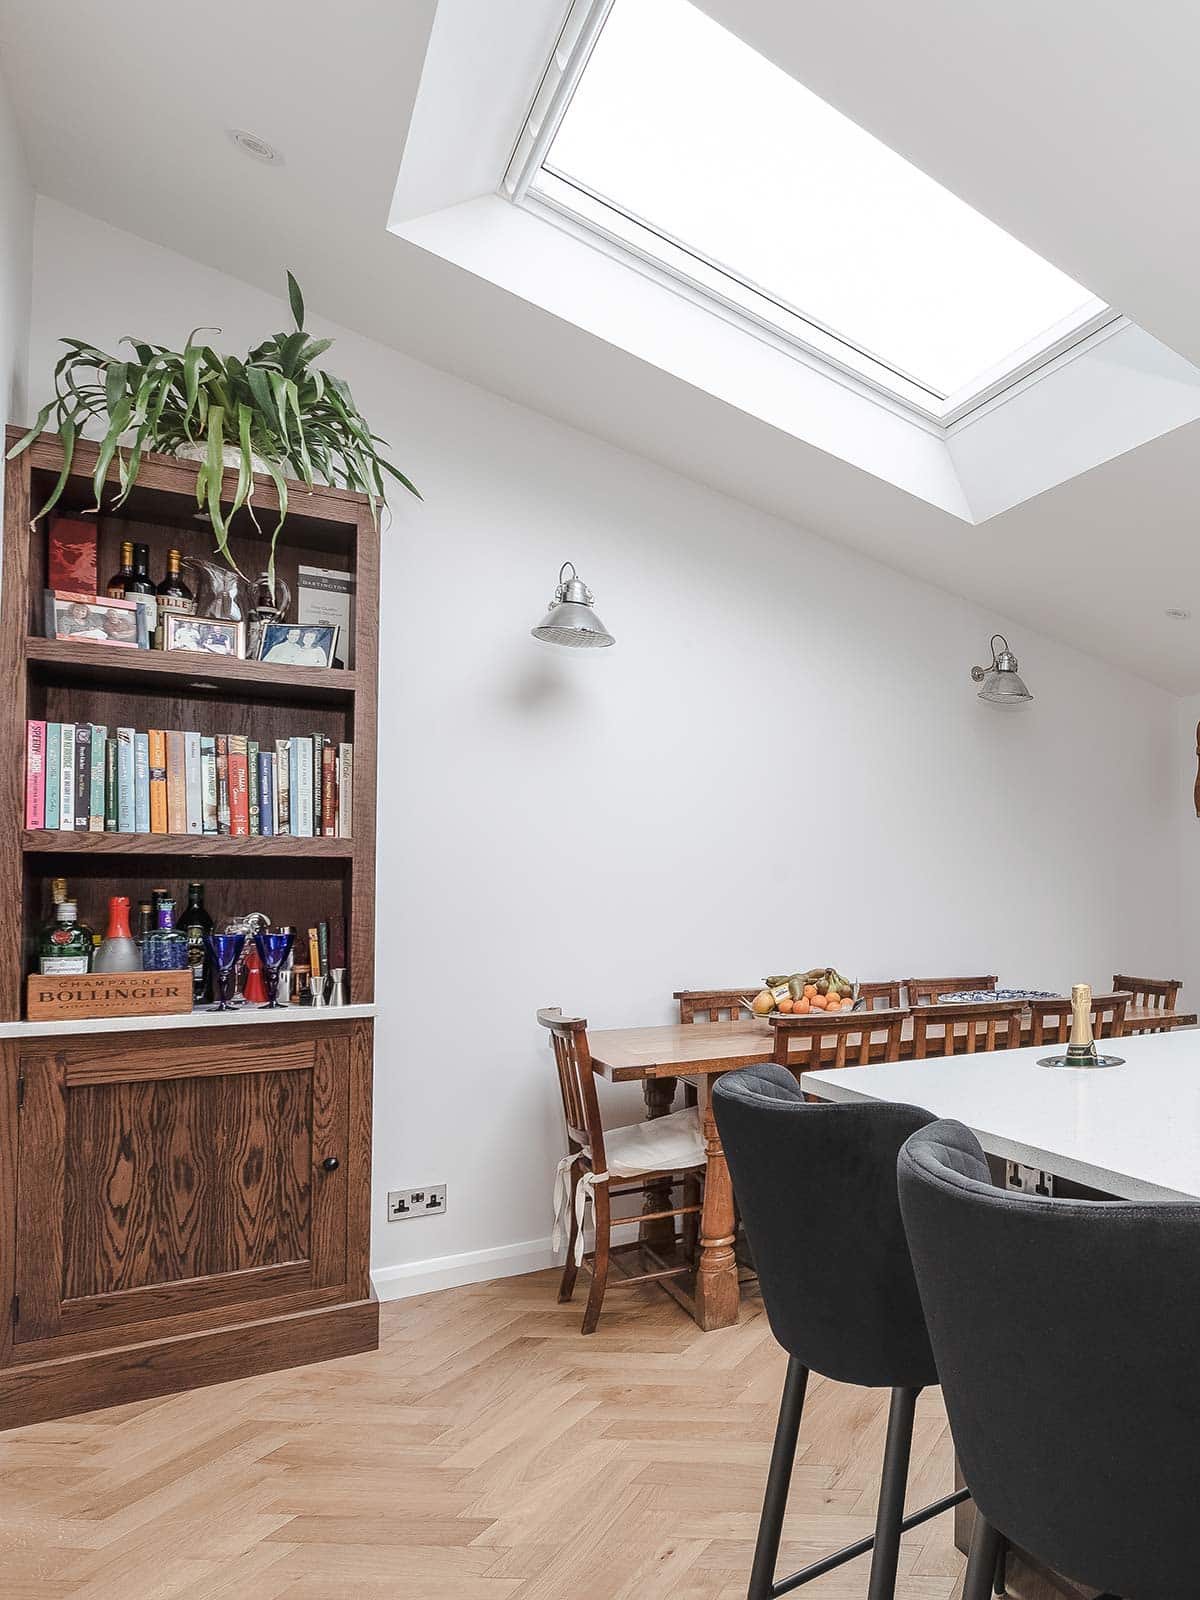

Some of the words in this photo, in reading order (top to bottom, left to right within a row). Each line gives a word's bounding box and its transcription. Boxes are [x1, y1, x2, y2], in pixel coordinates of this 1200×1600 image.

[302, 580, 347, 590] DARTINGTON
[31, 726, 41, 752] SPEEDY
[63, 729, 72, 741] TOM
[217, 738, 226, 754] Soup
[63, 742, 72, 768] KERRIDGE
[238, 768, 246, 792] ITALIAN
[58, 978, 161, 988] CHAMPAGNE
[39, 986, 179, 1002] BOLLINGER
